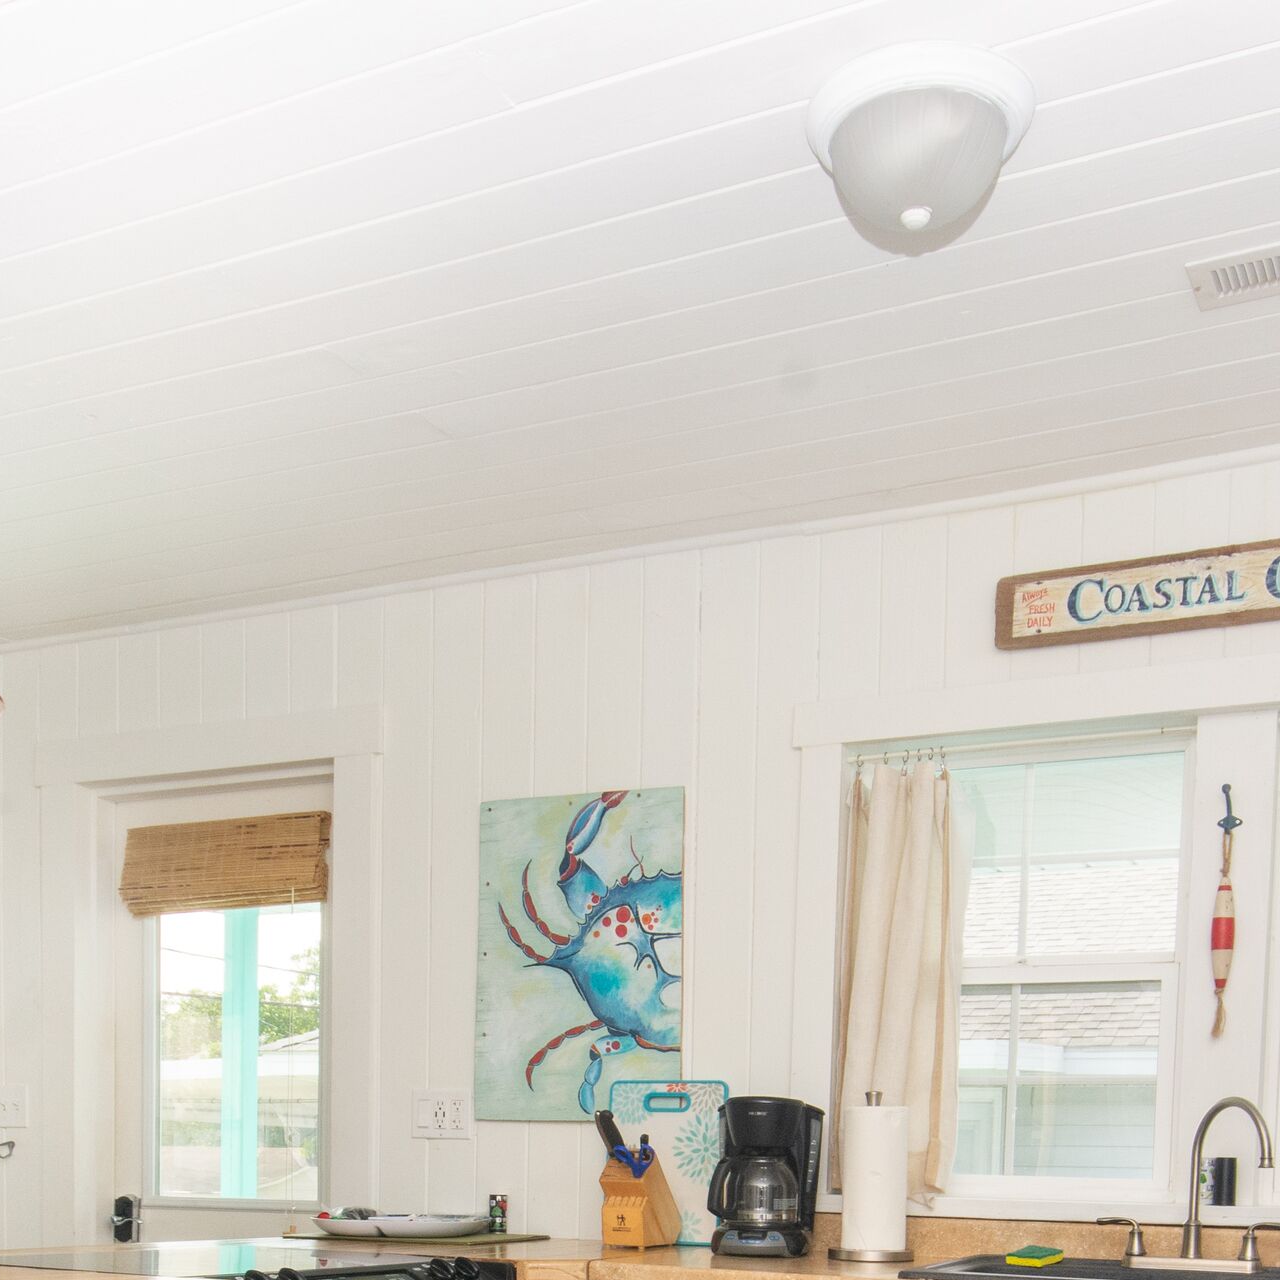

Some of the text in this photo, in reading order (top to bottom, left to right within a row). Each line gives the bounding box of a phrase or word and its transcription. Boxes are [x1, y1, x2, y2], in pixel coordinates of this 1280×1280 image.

[1067, 569, 1248, 624] COASTAL
[1028, 602, 1056, 615] FRESH
[1027, 616, 1054, 628] DAILY
